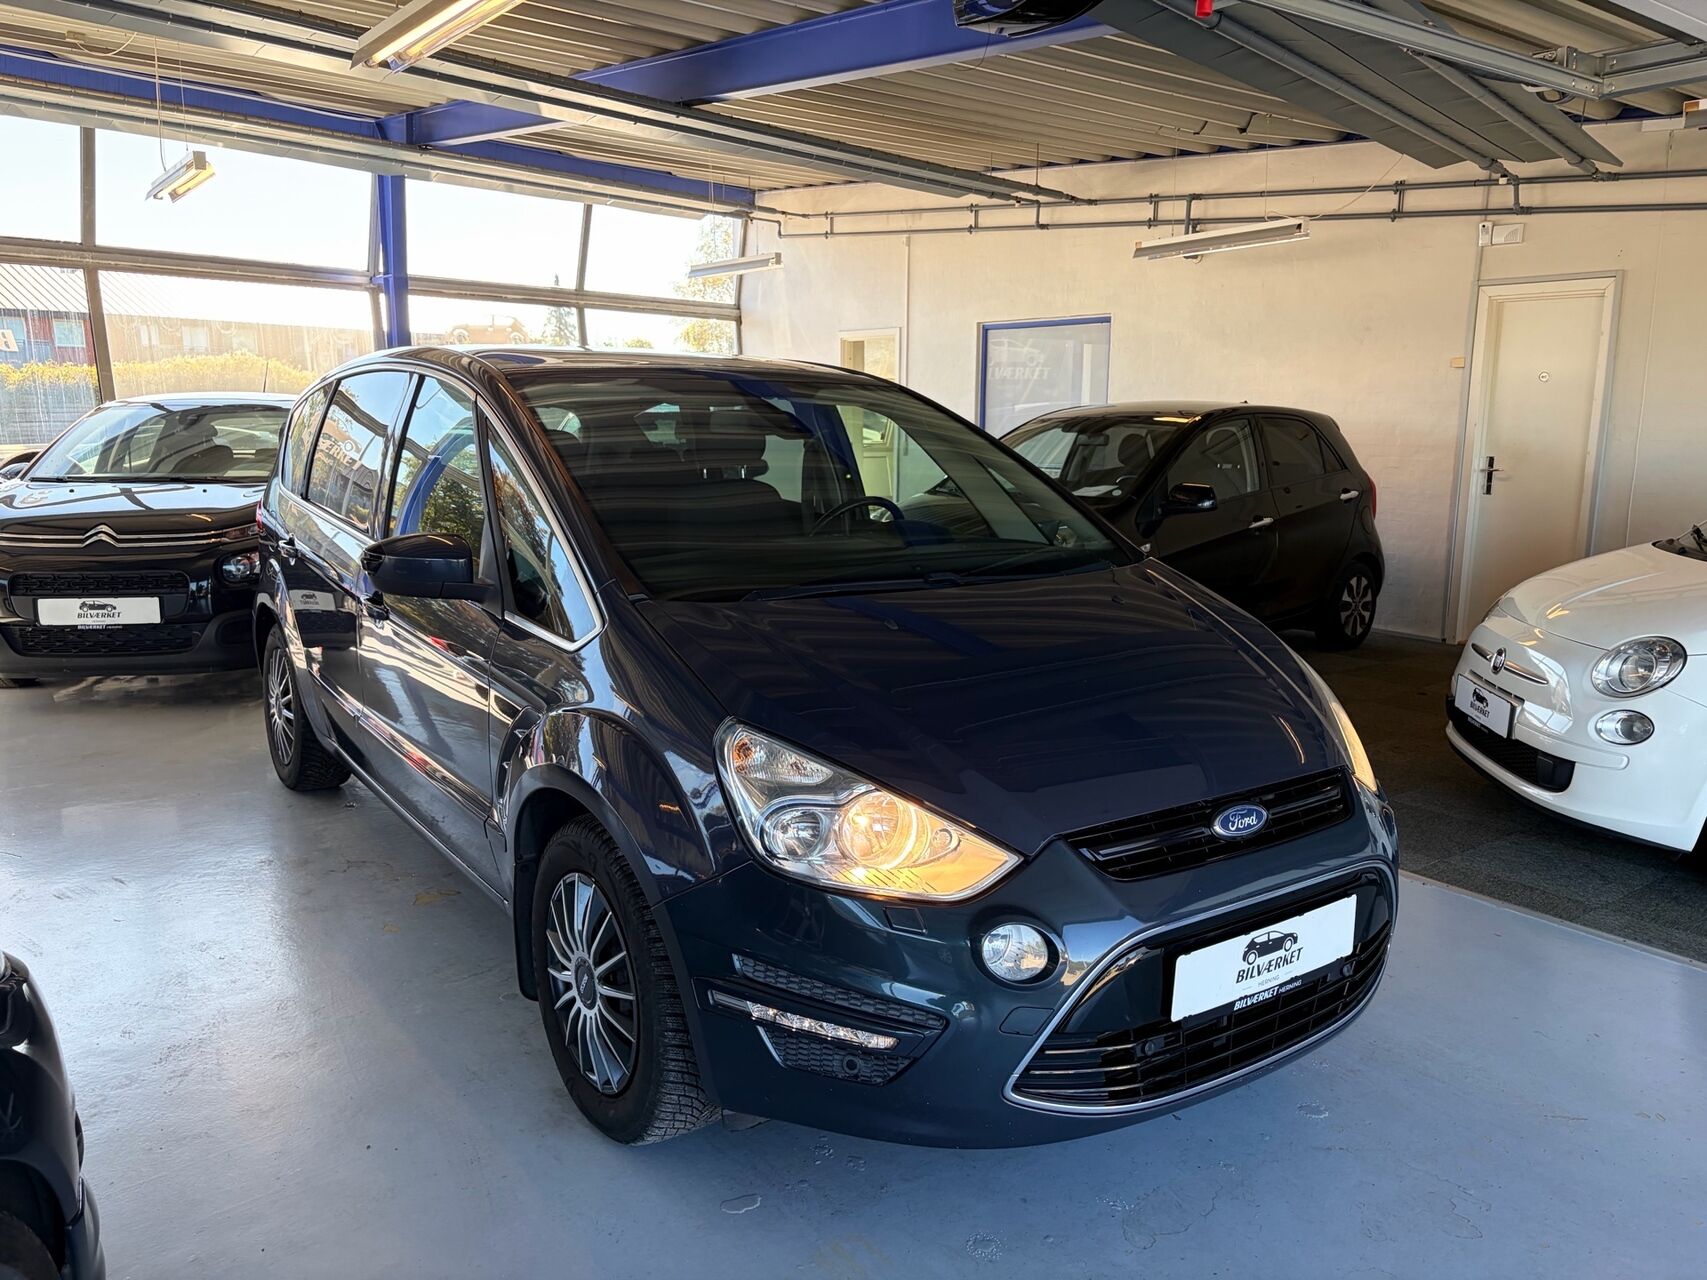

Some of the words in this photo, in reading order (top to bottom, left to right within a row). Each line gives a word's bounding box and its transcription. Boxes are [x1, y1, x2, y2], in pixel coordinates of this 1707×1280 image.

[77, 611, 122, 619] BILVÆRKET
[1229, 809, 1257, 831] Ford
[1236, 947, 1304, 984] BILVÆRKET
[1258, 974, 1280, 987] HERNING
[1234, 986, 1279, 1011] BILVÆRKET
